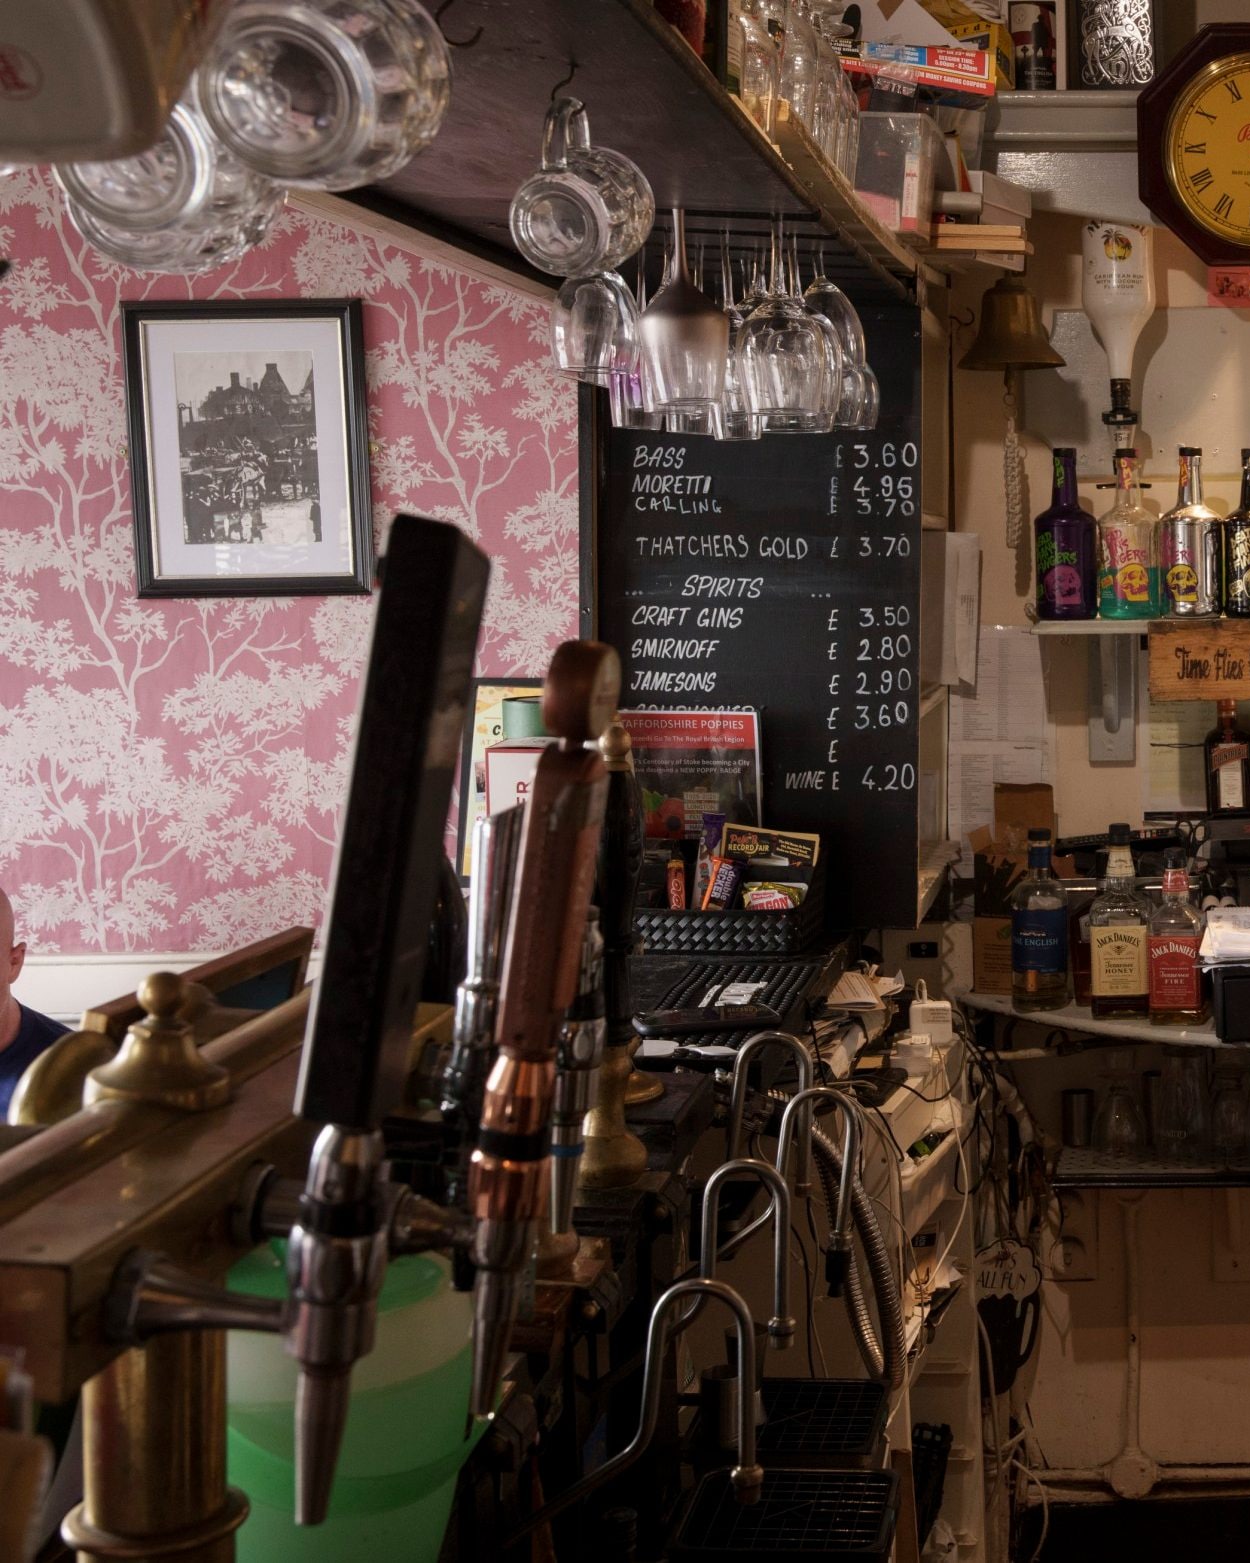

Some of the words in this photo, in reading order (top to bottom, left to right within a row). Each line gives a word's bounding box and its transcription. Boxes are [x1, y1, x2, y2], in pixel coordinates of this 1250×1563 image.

[634, 446, 687, 469] BASS
[854, 443, 918, 469] 3.60
[631, 475, 713, 494] MORETTI
[635, 497, 722, 515] CARLING
[856, 499, 915, 517] 3.70
[636, 535, 749, 559] THATCHERS
[759, 537, 808, 559] GOLD
[859, 535, 911, 558] 3.70
[681, 575, 764, 598] SPIRITS
[631, 606, 691, 627] CRAFT
[697, 607, 744, 629] GINS
[859, 605, 910, 628] 3.50
[631, 639, 719, 660] SMIRNOFF
[856, 634, 911, 661] 2.80
[1175, 645, 1211, 681] Time
[1213, 647, 1244, 681] Flies
[630, 671, 717, 692] JAMESONS
[855, 668, 912, 694] 2.90
[620, 719, 698, 730] TAFFORDSHIRE
[700, 719, 744, 730] POPPIES
[854, 700, 908, 730] 3.60
[724, 736, 745, 744] Legion
[785, 770, 825, 791] WINE
[861, 763, 915, 792] 4.20
[728, 842, 753, 852] RECORD
[710, 863, 734, 898] DECKER
[1025, 938, 1059, 947] ENGLISH
[1097, 935, 1113, 949] JACK
[1114, 932, 1141, 948] DANIEL'S
[1151, 945, 1168, 959] JACK
